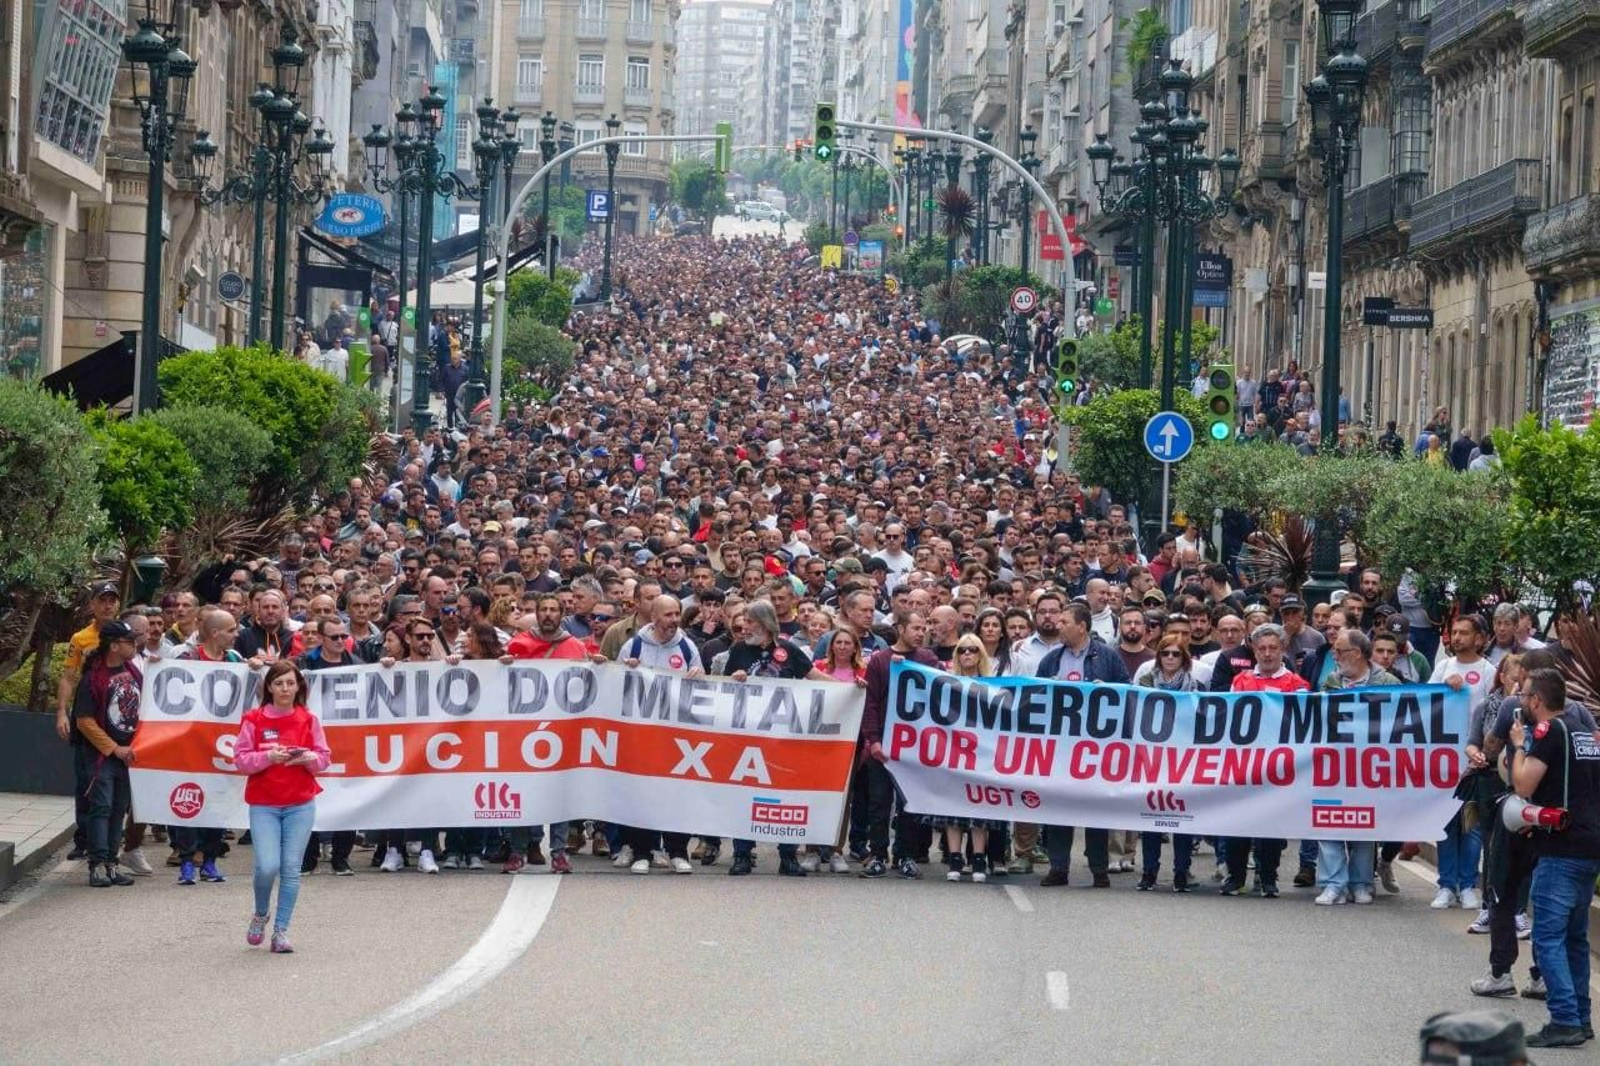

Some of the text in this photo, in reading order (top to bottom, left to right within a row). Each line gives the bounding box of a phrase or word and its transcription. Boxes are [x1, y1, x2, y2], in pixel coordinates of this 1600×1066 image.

[594, 195, 607, 209] P
[1017, 295, 1031, 303] 40
[153, 667, 841, 735] COENIO DO METAL
[896, 669, 1459, 746] COMERCIO DO METAL
[212, 721, 773, 786] SUCIÓN XA
[890, 723, 1460, 789] POR UN CONVENIO DIGNO
[175, 787, 201, 803] UGT
[475, 781, 521, 810] CIG
[966, 783, 1014, 807] UGT
[1147, 790, 1186, 811] CIG
[475, 811, 521, 819] INDUSTRIA
[755, 806, 805, 821] CCOO
[1316, 810, 1371, 824] CCOO
[750, 821, 806, 837] industria
